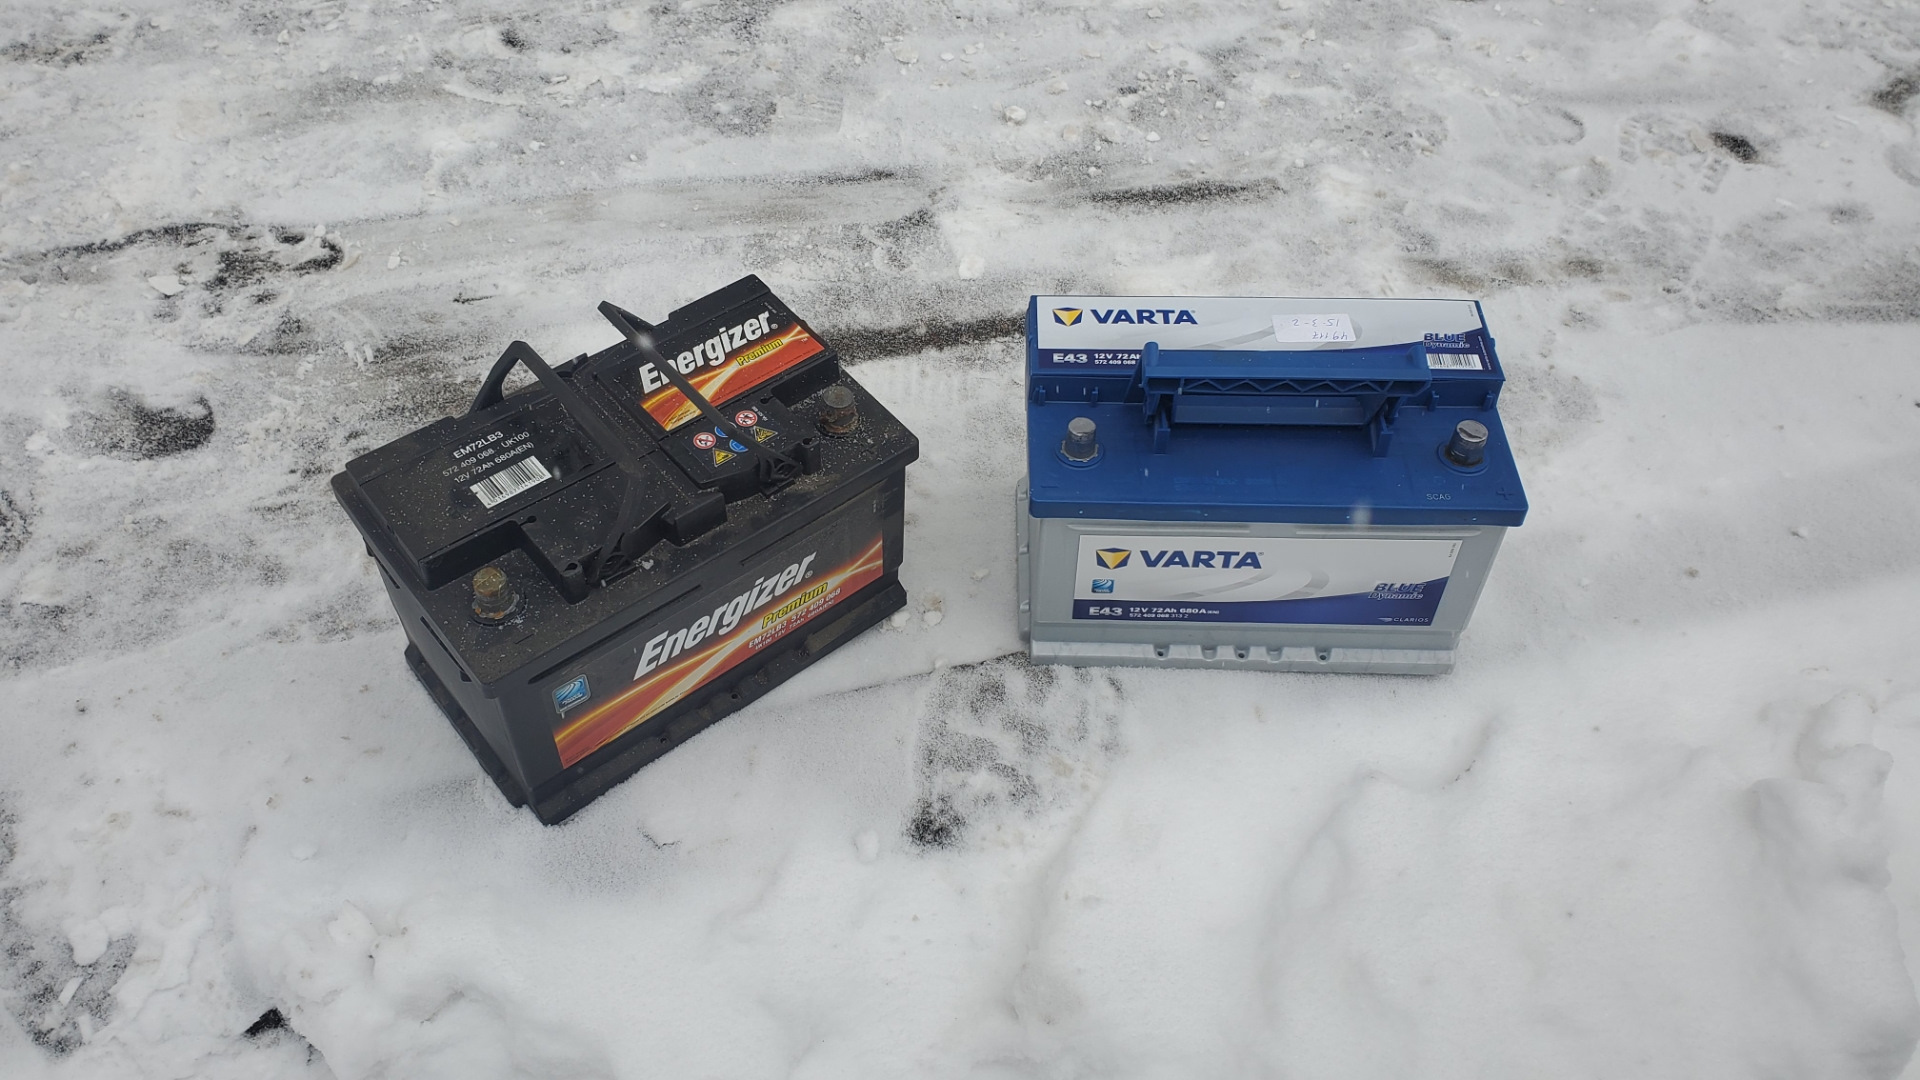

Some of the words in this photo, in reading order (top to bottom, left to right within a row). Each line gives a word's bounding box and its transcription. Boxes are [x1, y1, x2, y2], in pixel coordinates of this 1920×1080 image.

[1090, 309, 1198, 325] VARTA
[1424, 332, 1466, 342] BLUE
[736, 339, 784, 366] Premium
[1052, 353, 1088, 364] E43
[442, 465, 460, 477] 572
[460, 456, 477, 468] 409
[477, 448, 495, 460] 068
[501, 431, 530, 448] UK100
[453, 431, 504, 459] EM72LB3
[454, 472, 470, 483] 12V
[471, 461, 495, 475] 72Ah
[1140, 550, 1262, 569] VARTA
[1373, 582, 1426, 593] BLUE
[633, 551, 817, 681] Energizer
[762, 582, 829, 629] Premium
[1089, 606, 1123, 616] E43
[748, 620, 787, 649] EM72LB3
[791, 608, 807, 622] 572
[809, 598, 824, 611] 409
[826, 587, 841, 602] 068
